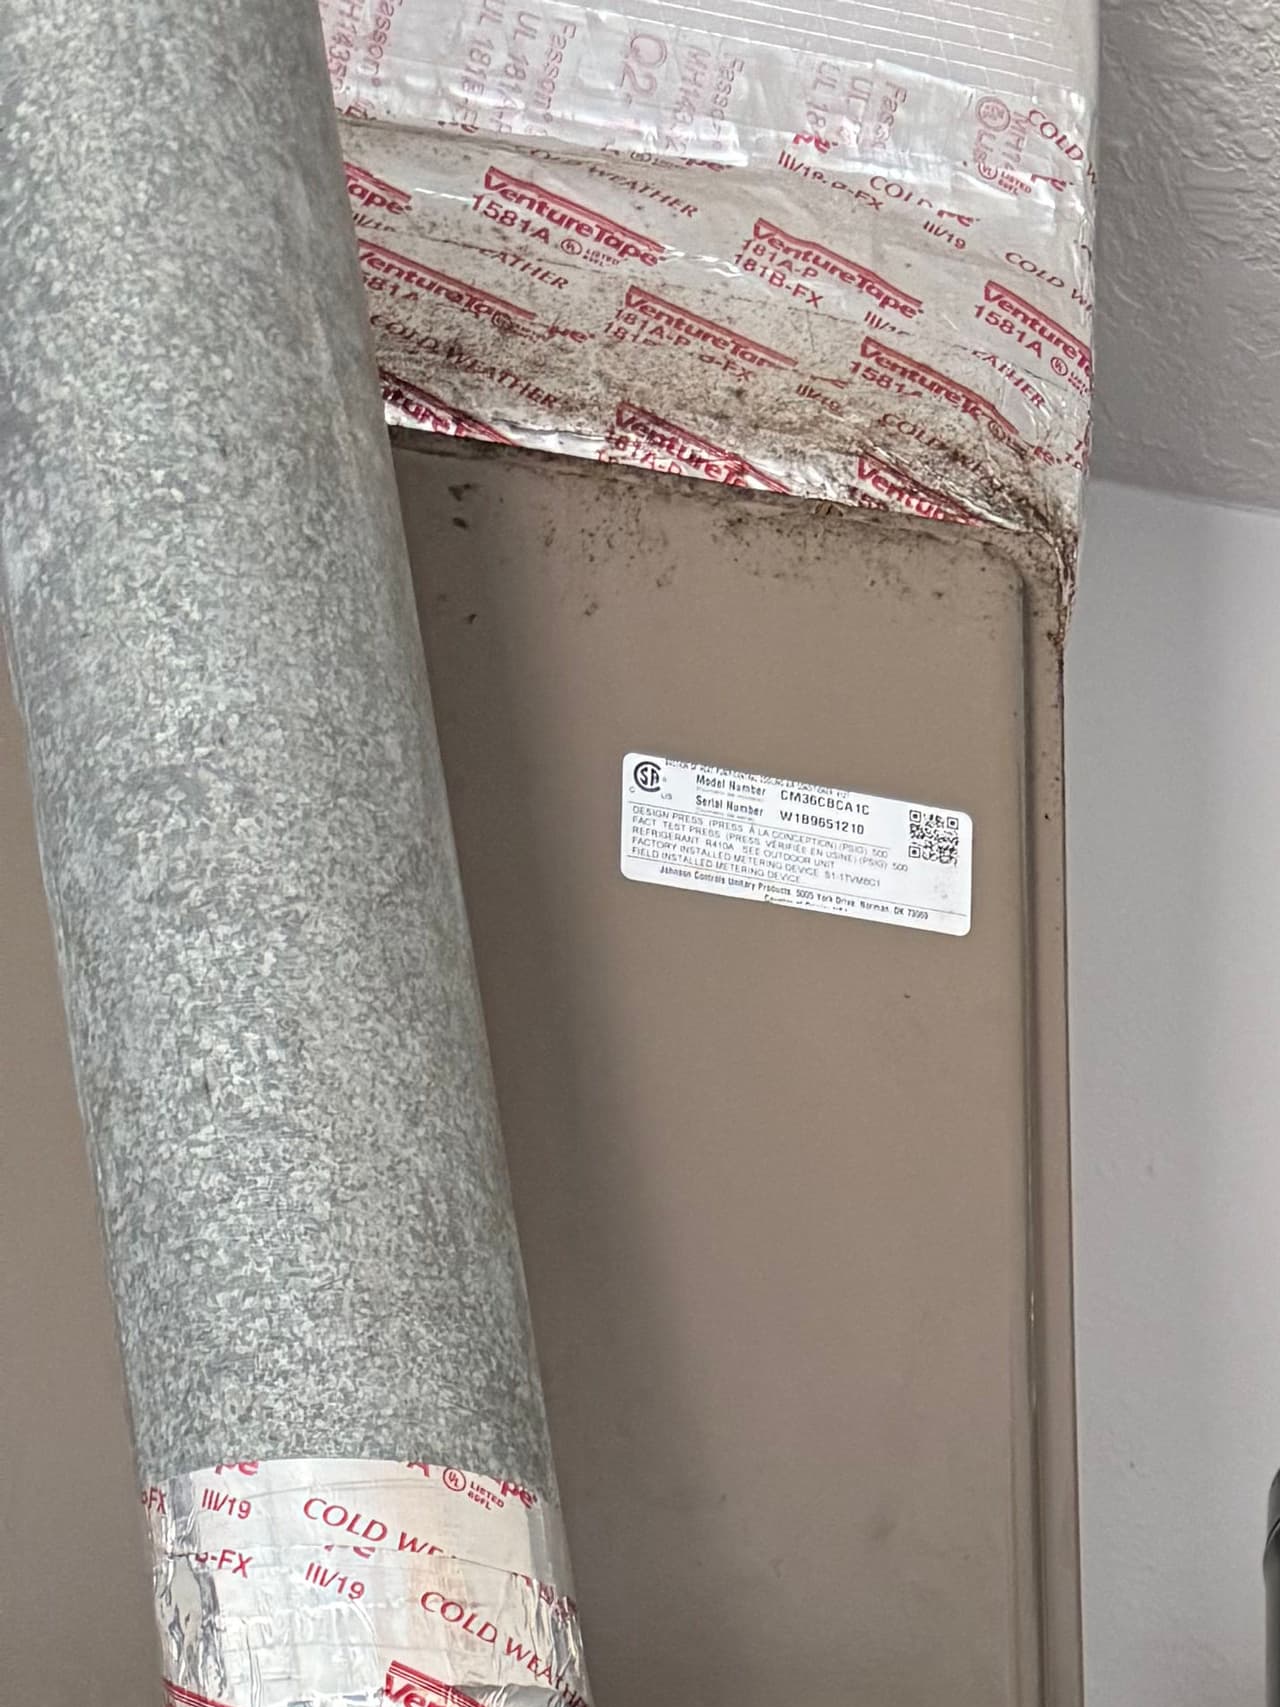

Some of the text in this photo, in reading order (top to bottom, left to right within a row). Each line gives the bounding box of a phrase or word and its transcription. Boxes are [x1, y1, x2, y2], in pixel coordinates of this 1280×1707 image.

[471, 195, 550, 244] 1581A
[742, 239, 818, 280] 181A-P
[1005, 252, 1066, 288] COLD
[733, 253, 823, 309] 181B-FX
[973, 303, 1043, 358] 1581A
[696, 775, 725, 789] Model
[729, 780, 766, 796] Number
[633, 806, 703, 825] DESIGN PRESS
[696, 795, 723, 809] Serial
[727, 801, 763, 817] Number
[632, 826, 699, 845] REFRIGERANT
[632, 836, 731, 861] FACTORY INSTALLED
[303, 1497, 388, 1543] COLD
[419, 1590, 498, 1645] COLD
